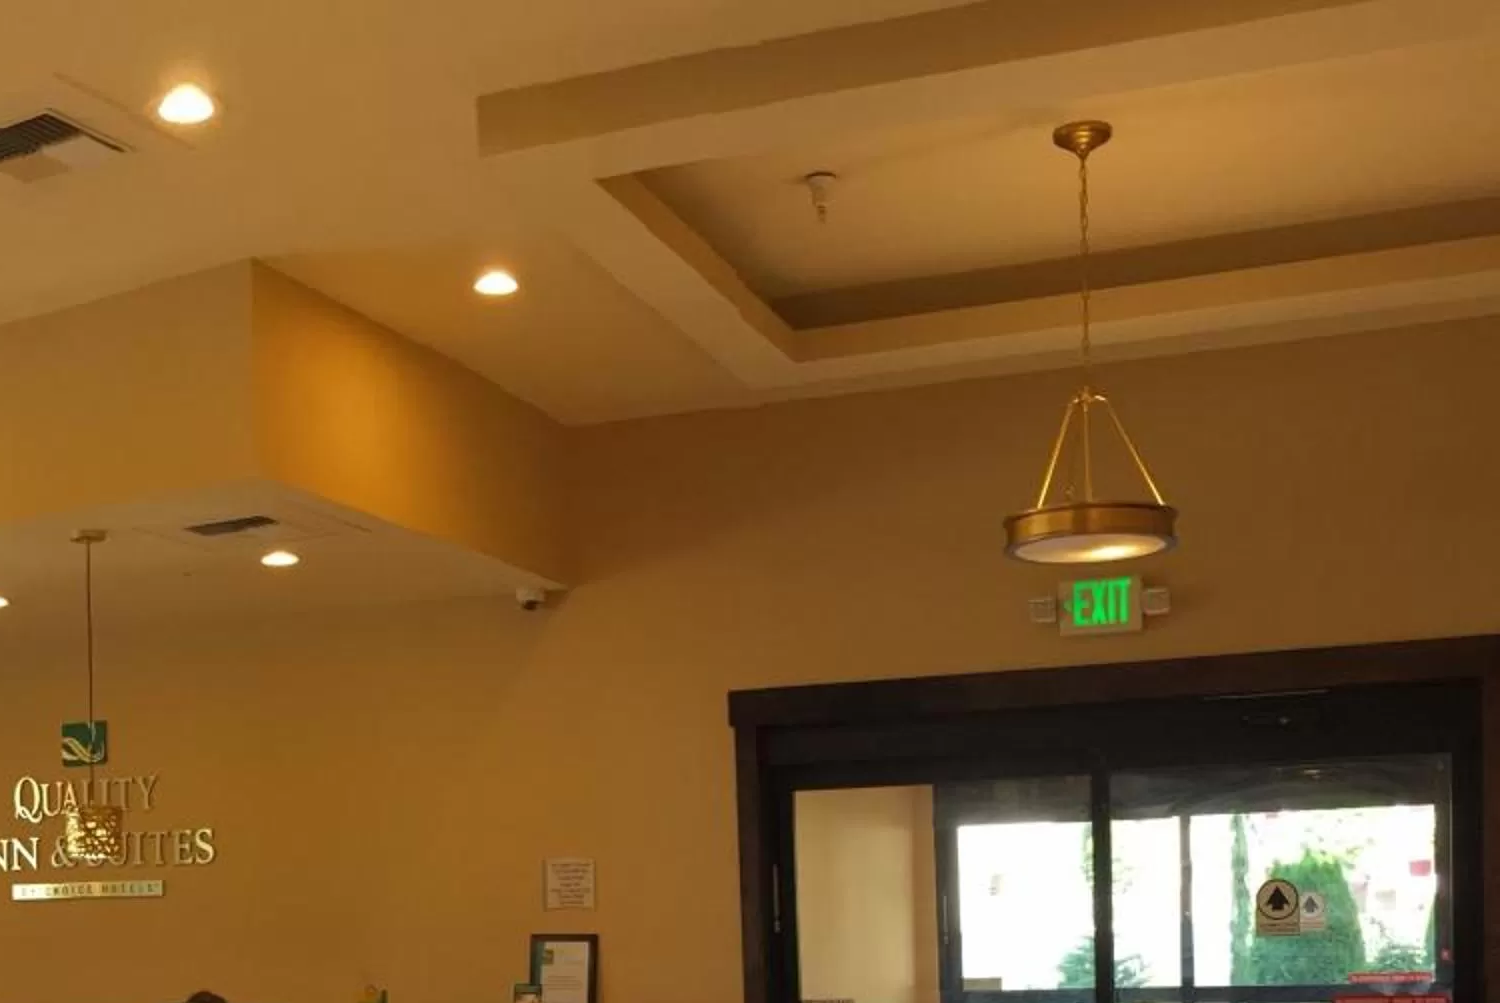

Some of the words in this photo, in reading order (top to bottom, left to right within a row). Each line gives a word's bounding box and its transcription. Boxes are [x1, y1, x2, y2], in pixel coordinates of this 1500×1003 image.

[1073, 576, 1131, 626] EXIT
[14, 775, 157, 823] QUALITY
[86, 828, 216, 868] UITES
